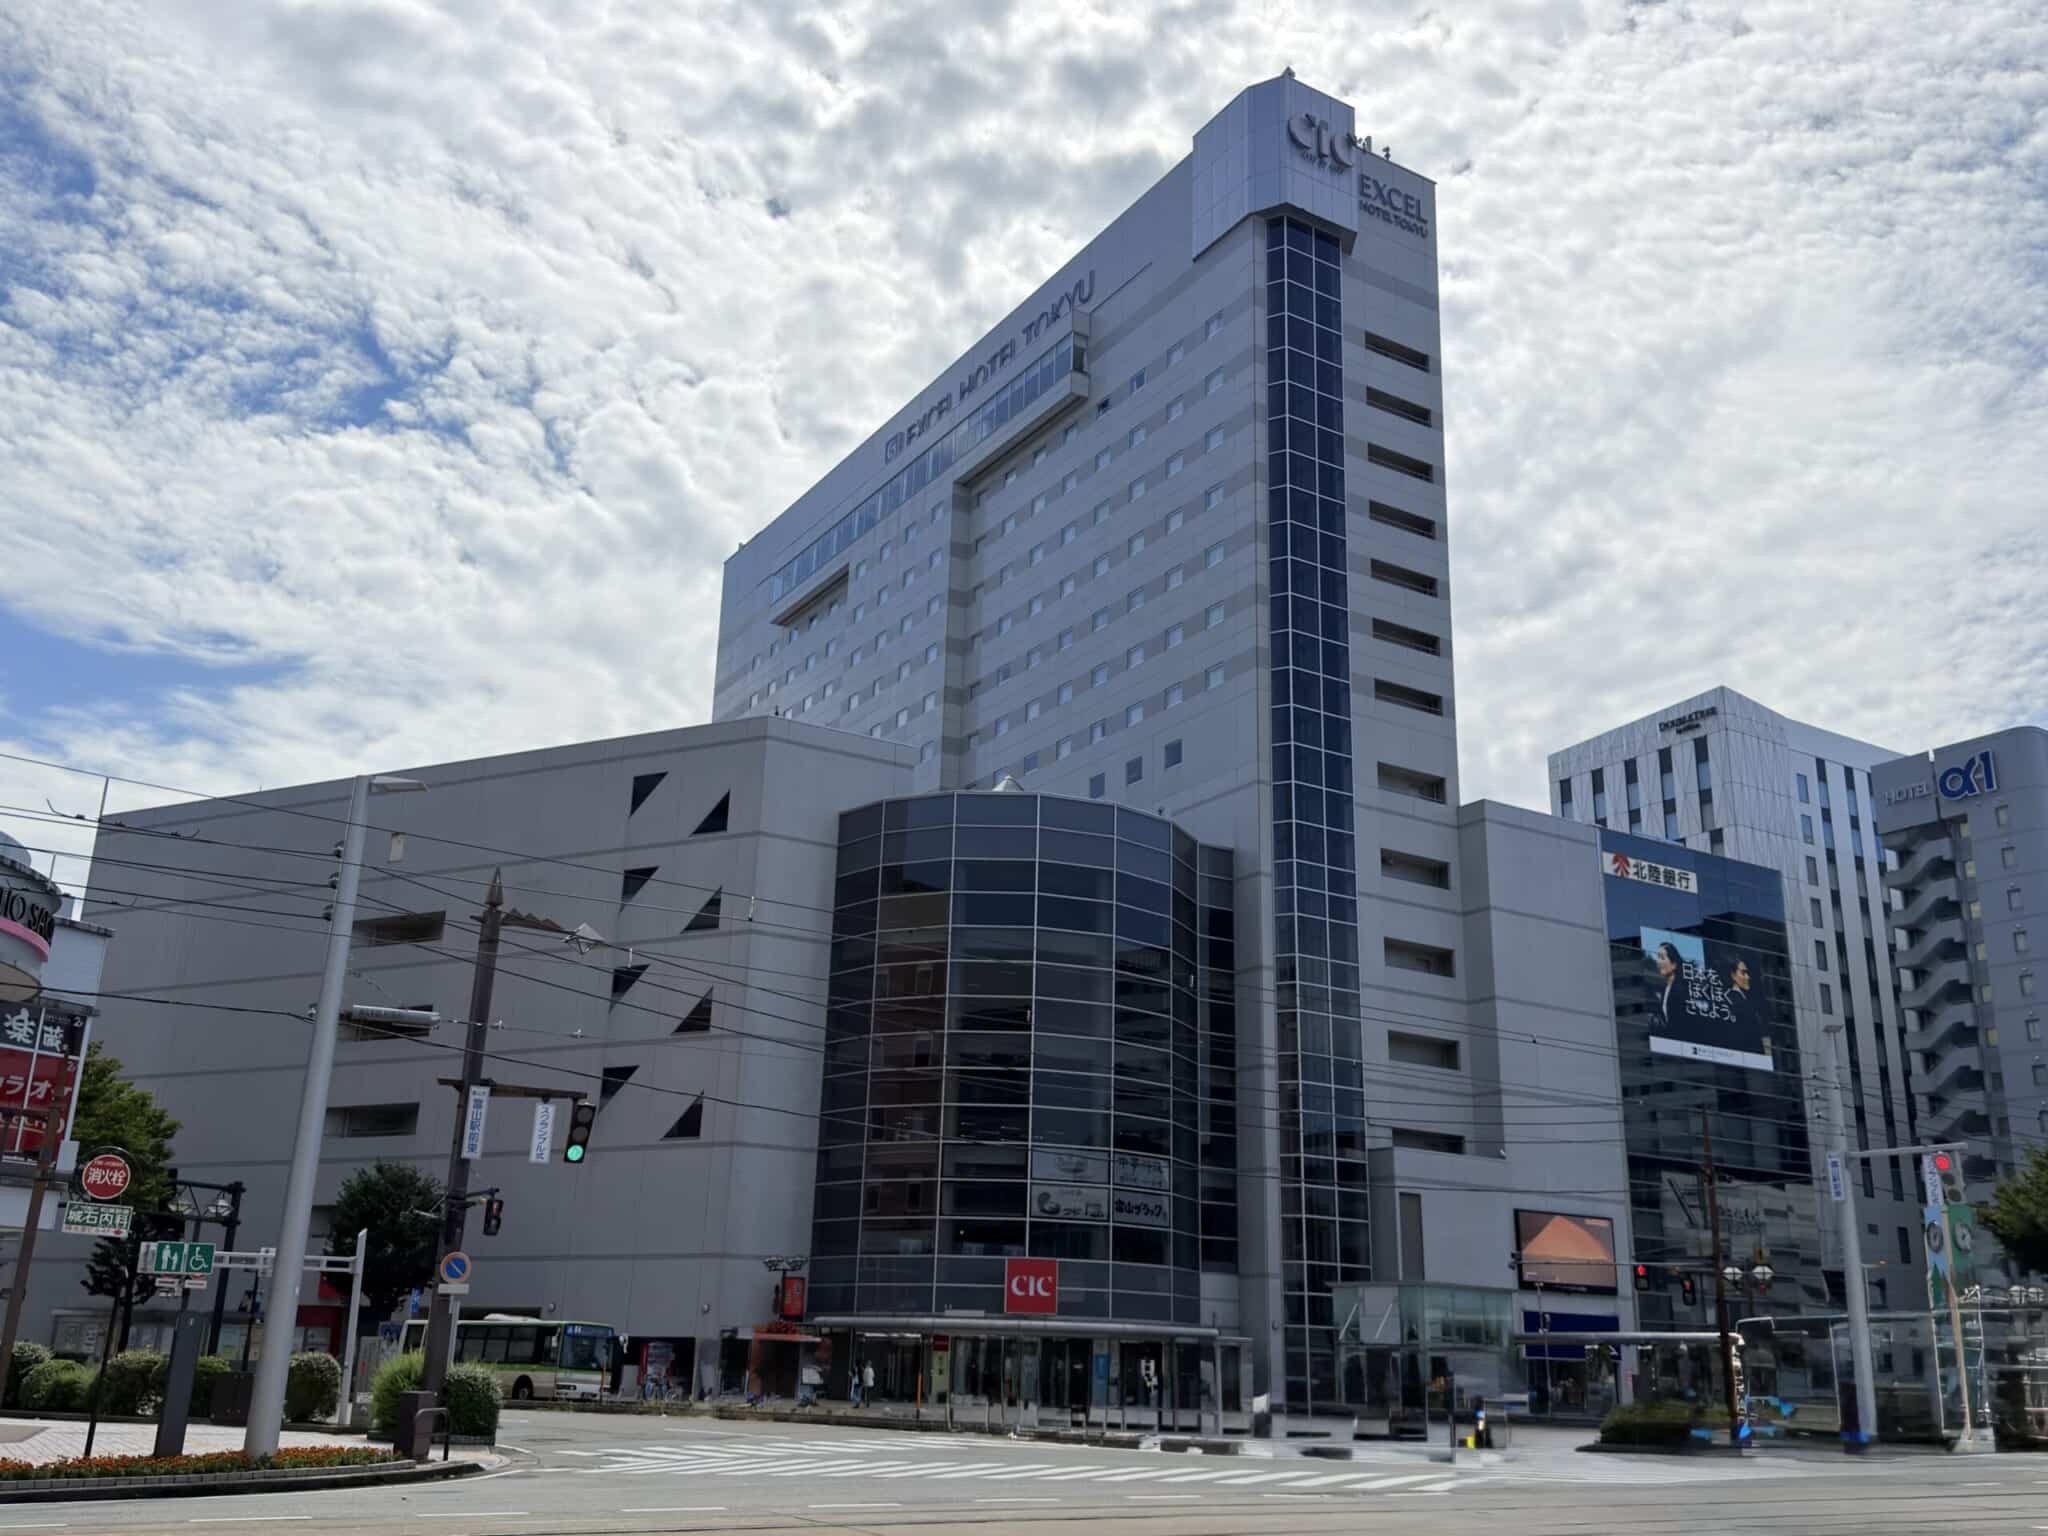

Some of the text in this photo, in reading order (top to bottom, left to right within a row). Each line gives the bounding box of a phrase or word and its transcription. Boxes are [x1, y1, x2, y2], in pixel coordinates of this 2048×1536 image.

[1288, 111, 1357, 169] CIC
[1360, 173, 1429, 226] EXCEL
[1359, 199, 1428, 239] HOTEL TOKYU
[906, 269, 1096, 448] EXCEL HOTEL TOKYU
[1883, 780, 1931, 805] HOTEL
[1632, 861, 1692, 891] 北陸銀行
[88, 1167, 125, 1186] 消火栓
[1011, 1274, 1053, 1297] CIC
